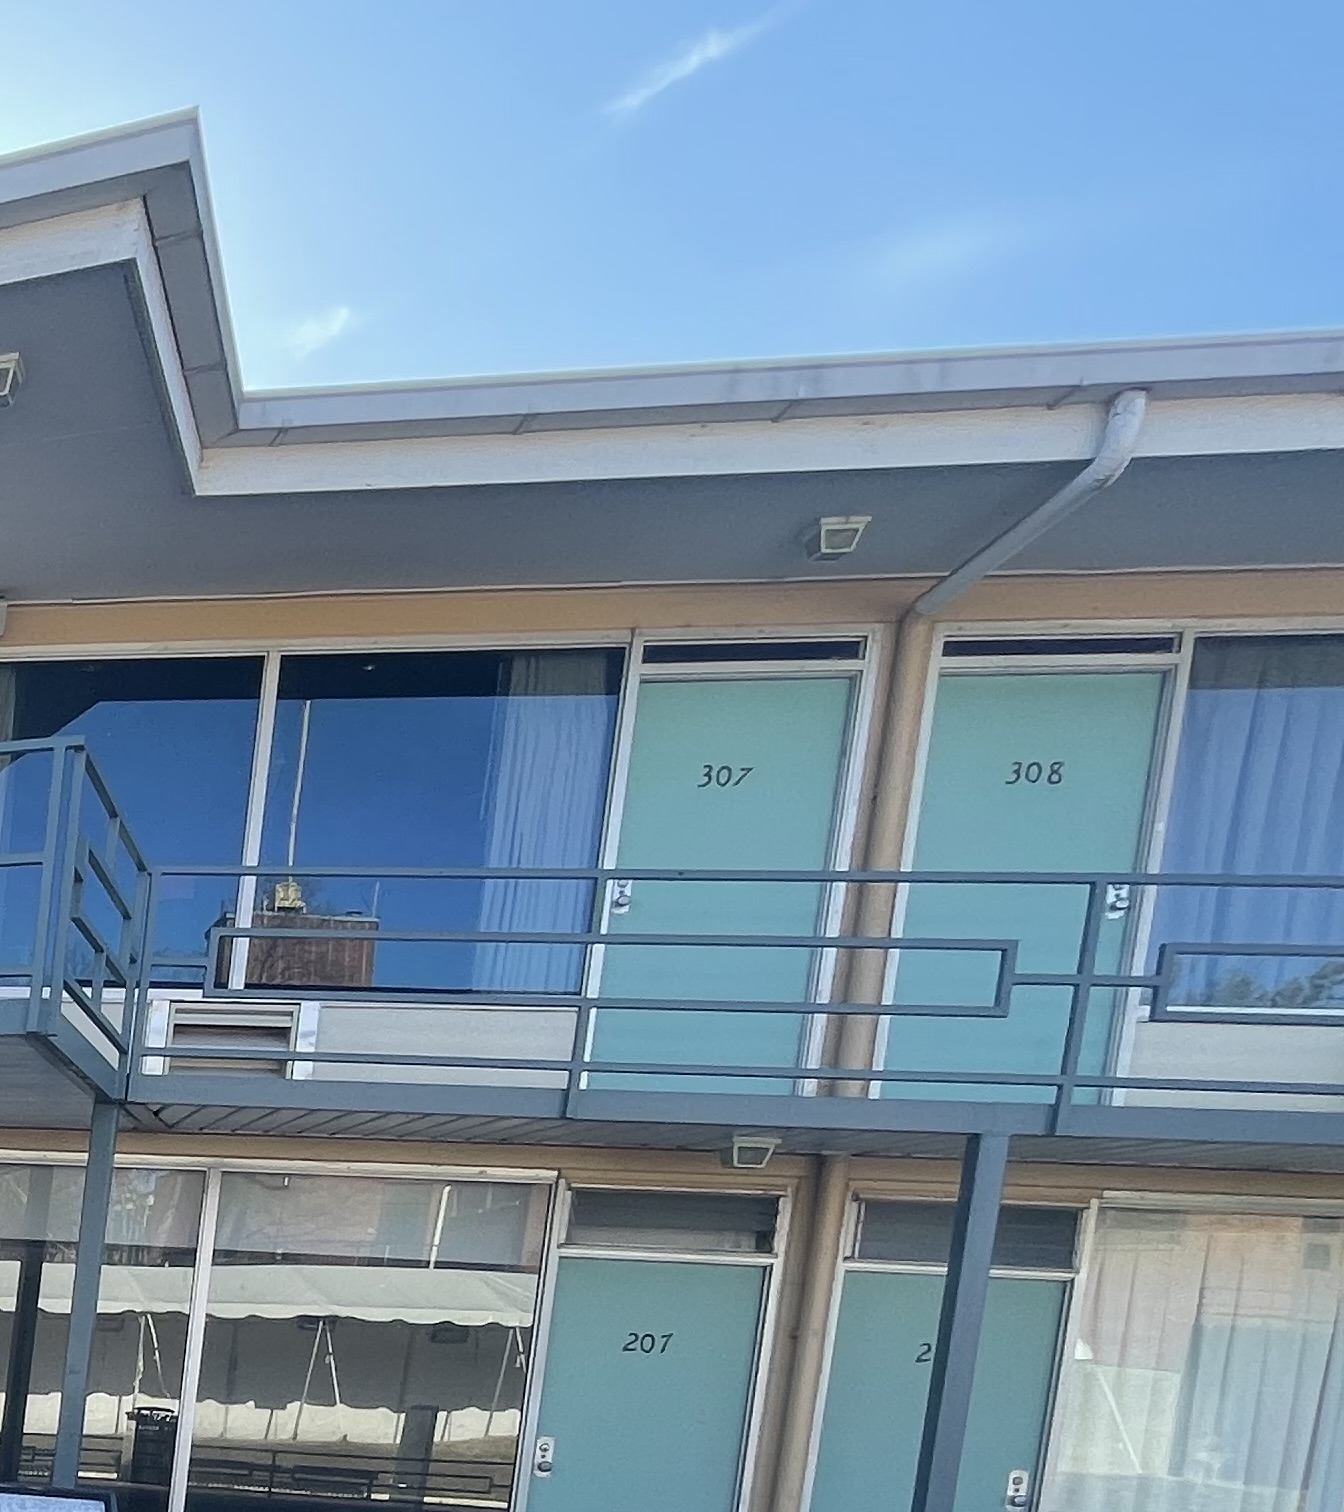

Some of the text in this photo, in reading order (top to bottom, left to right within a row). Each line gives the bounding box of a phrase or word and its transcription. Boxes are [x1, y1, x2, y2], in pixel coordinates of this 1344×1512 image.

[697, 764, 755, 788] 307
[1005, 761, 1065, 785] 308
[622, 1333, 674, 1354] 207
